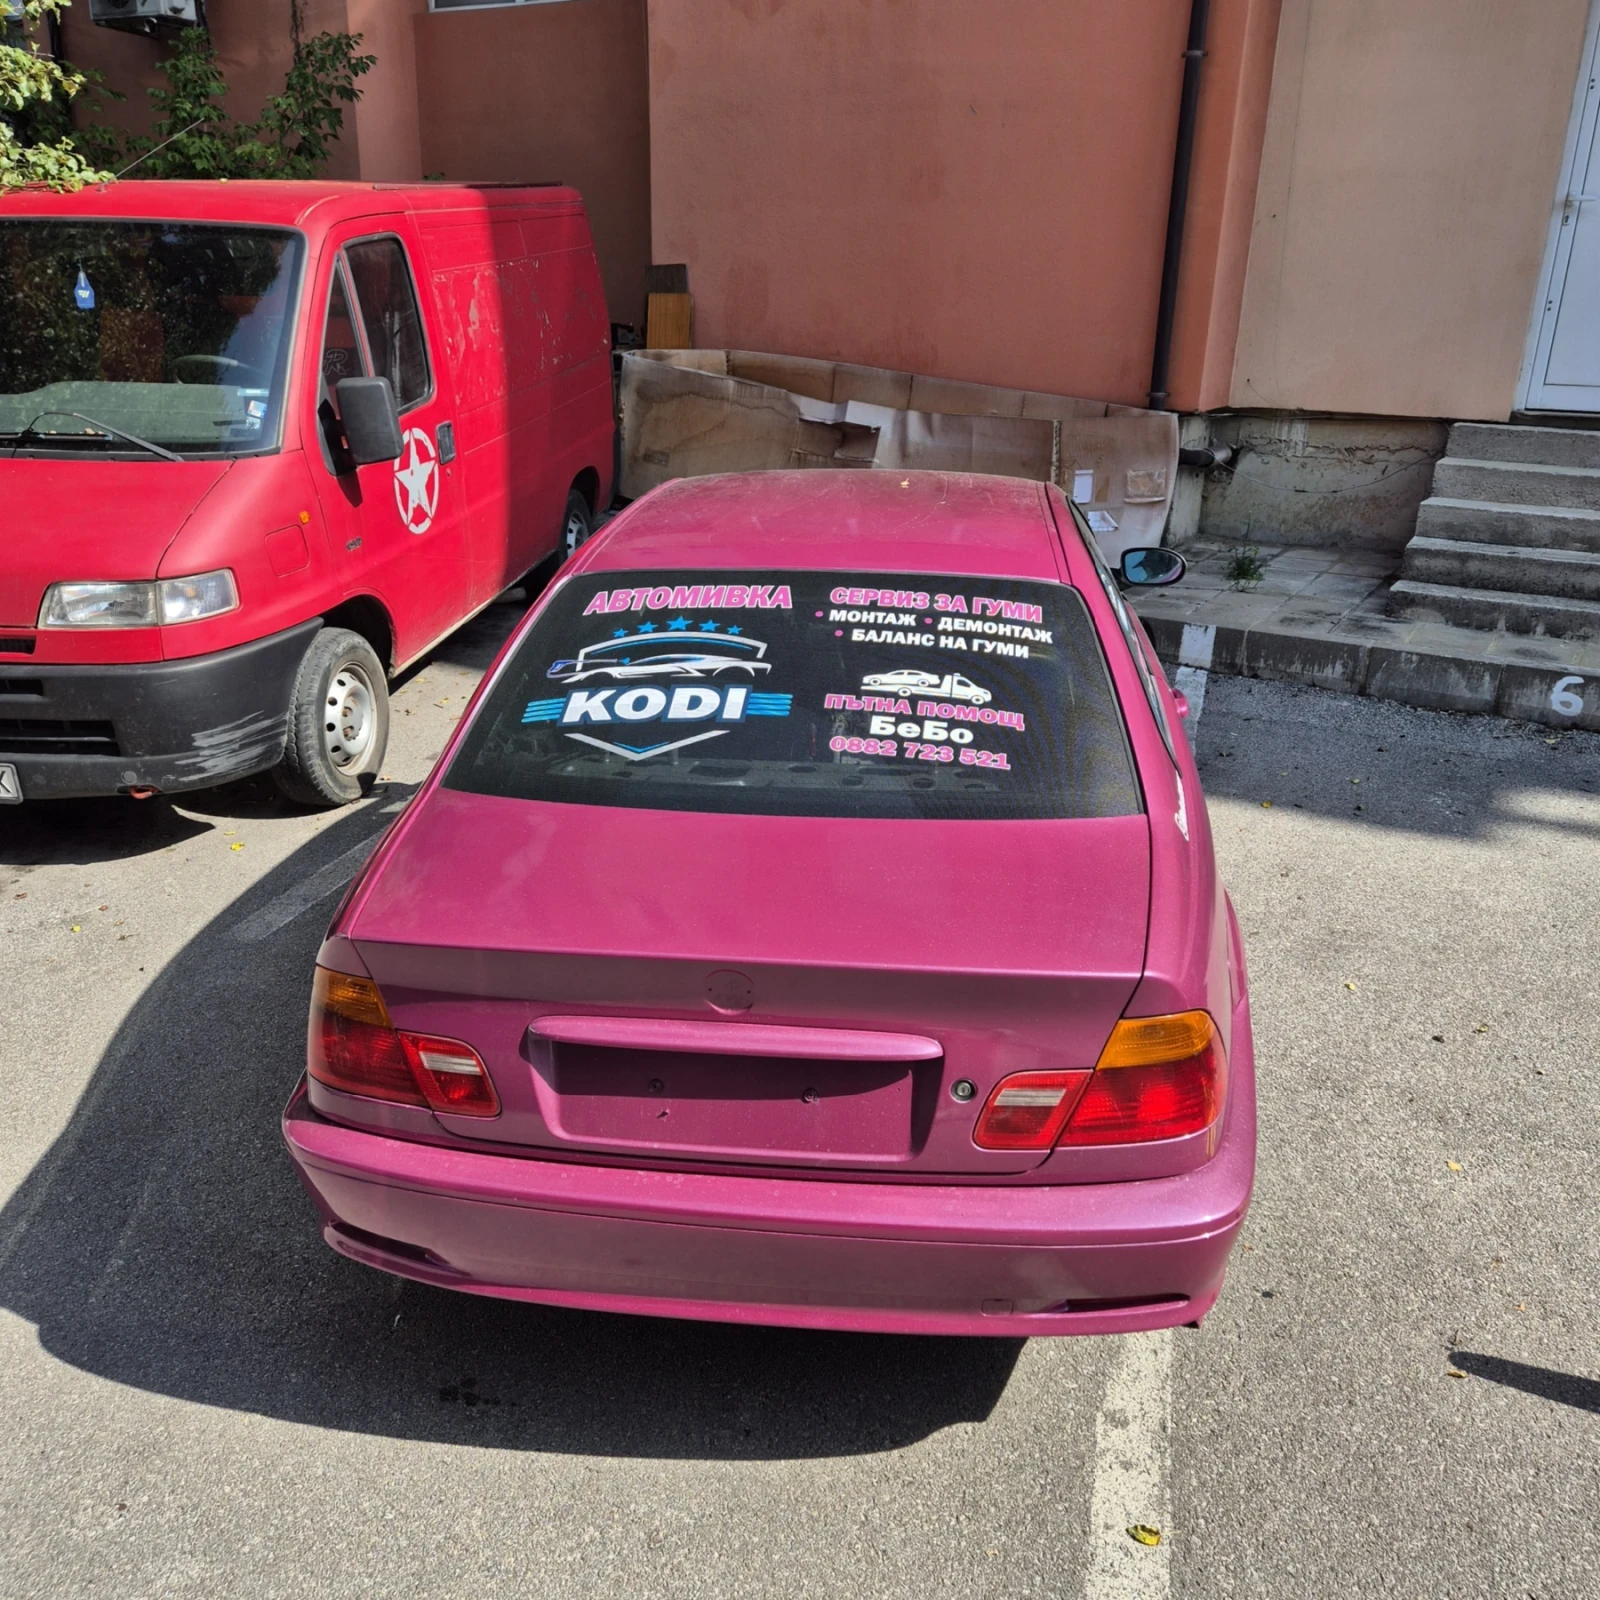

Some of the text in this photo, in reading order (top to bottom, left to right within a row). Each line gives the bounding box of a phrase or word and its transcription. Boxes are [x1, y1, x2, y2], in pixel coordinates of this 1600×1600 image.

[583, 585, 793, 616] АВТОМИВКА
[830, 587, 1043, 623] СЕРВИЗ ЗА ГУМИ
[829, 609, 1053, 644] МОНТАЖ ДЕМОНТАЖ
[851, 629, 1030, 659] БАЛАНС НА ГУМИ
[560, 686, 750, 724] KODI
[824, 693, 1025, 731] ПЪТНА ПОМОЩ
[1550, 676, 1585, 716] 6
[869, 715, 974, 744] БеБо
[829, 735, 1011, 770] 0882 723 521
